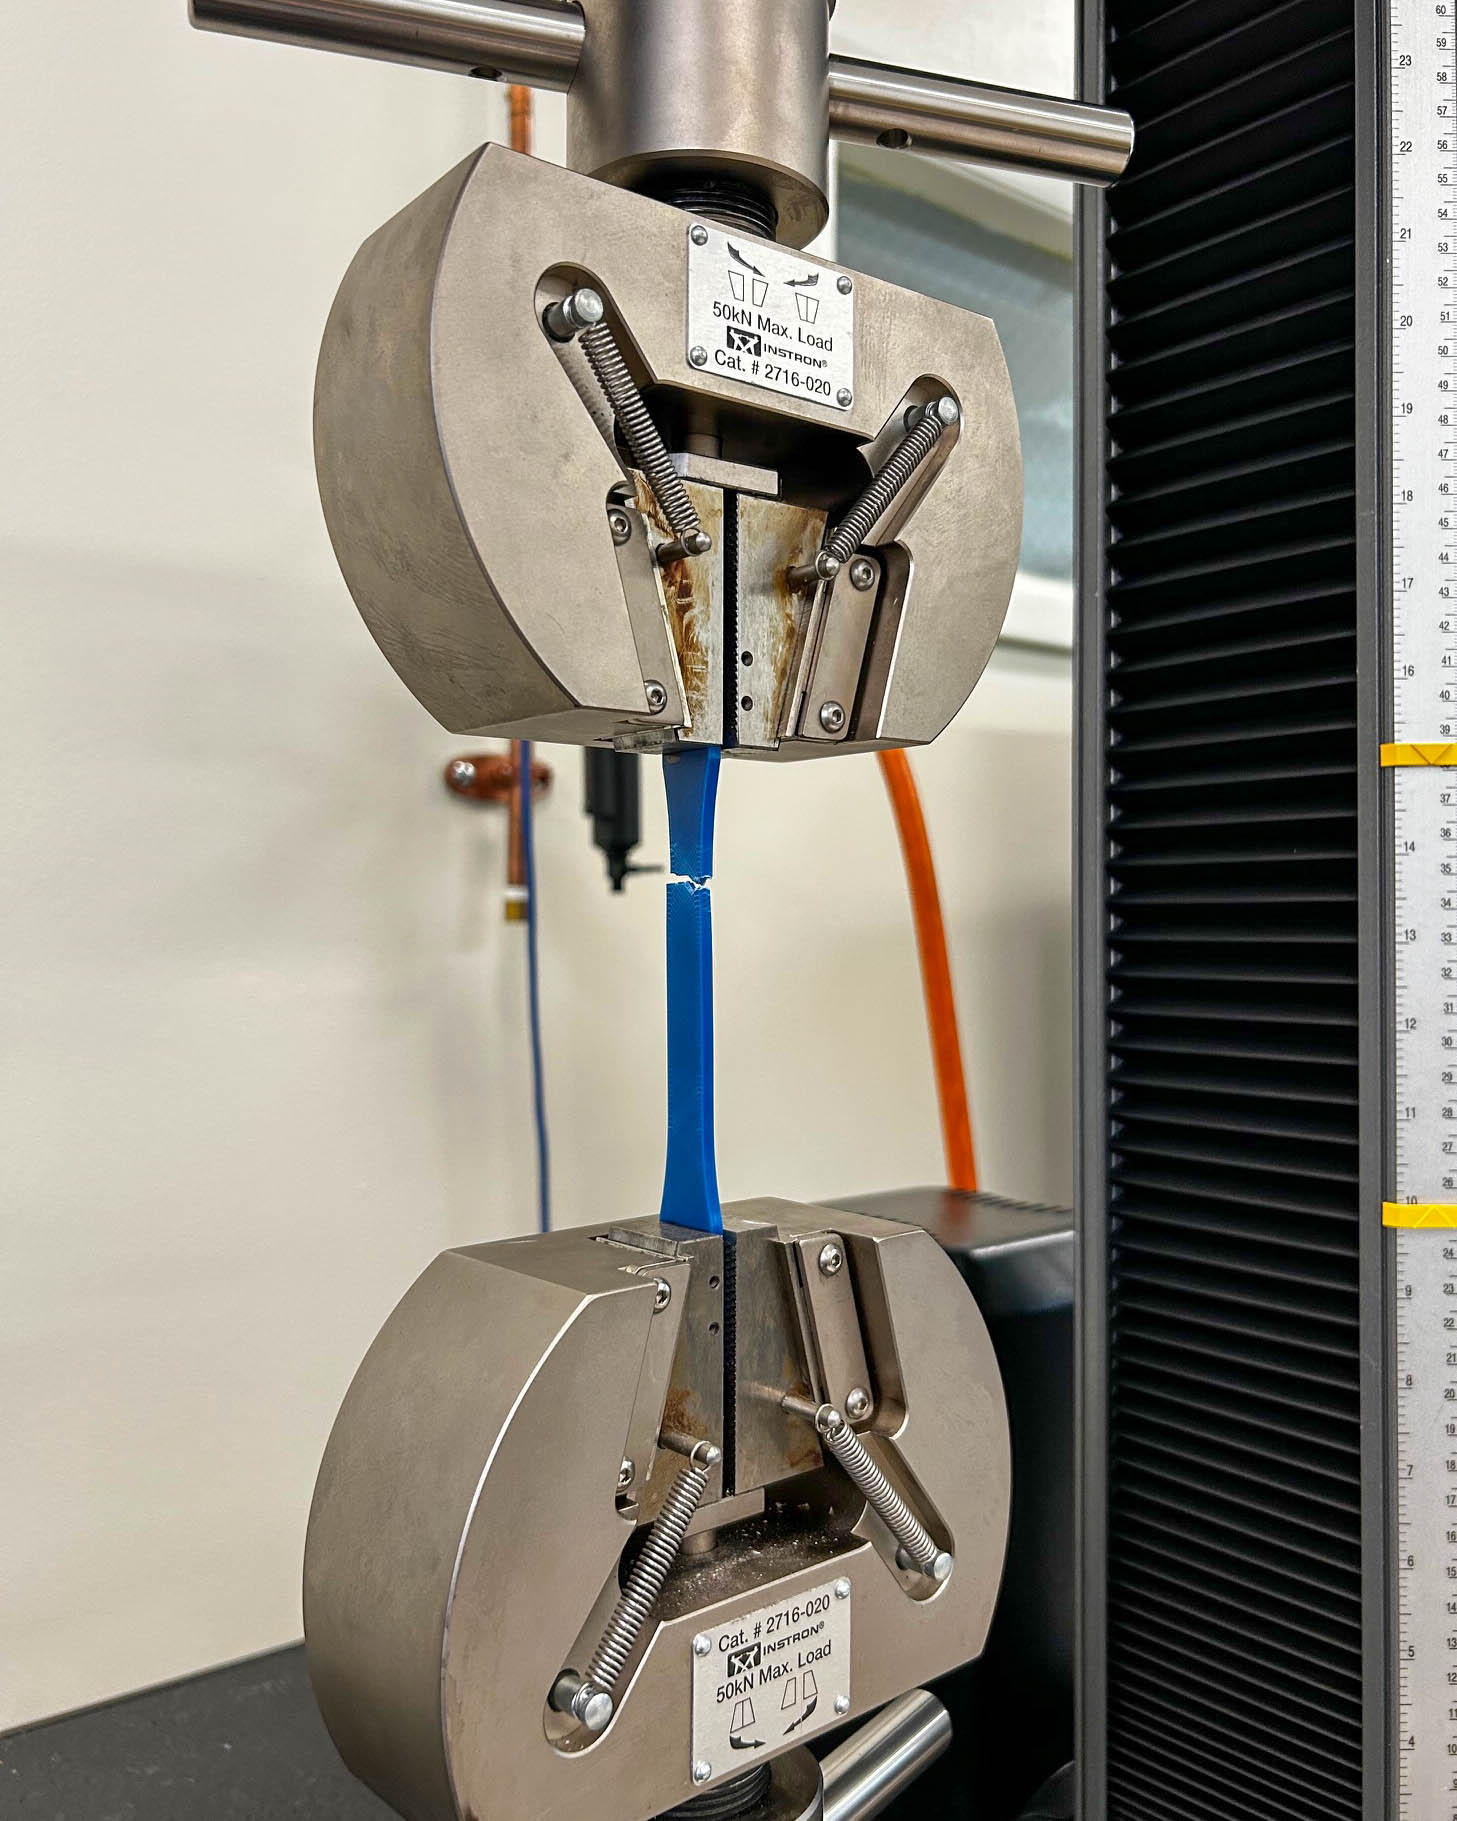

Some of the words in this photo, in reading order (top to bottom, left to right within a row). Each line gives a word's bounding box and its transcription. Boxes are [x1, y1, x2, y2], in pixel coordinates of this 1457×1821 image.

[1436, 5, 1446, 14] 60
[1436, 38, 1446, 47] 59
[1399, 55, 1411, 66] 23
[1437, 72, 1447, 81] 58
[1437, 106, 1447, 115] 57
[1400, 141, 1412, 152] 22
[1437, 140, 1447, 149] 56
[1438, 174, 1447, 183] 55
[1438, 209, 1448, 217] 54
[1400, 228, 1411, 239] 21
[1438, 243, 1448, 252] 53
[1438, 277, 1448, 286] 52
[1400, 315, 1412, 326] 20
[1440, 312, 1450, 320] 51
[713, 300, 752, 327] 50kN
[757, 313, 793, 340] Max.
[798, 326, 833, 352] Load
[1438, 346, 1448, 355] 50
[715, 349, 746, 372] Cat.
[751, 360, 760, 376] #
[765, 363, 831, 396] 2716-020
[1438, 380, 1448, 389] 49
[1401, 403, 1412, 414] 19
[1438, 415, 1448, 424] 48
[1438, 449, 1448, 458] 47
[1438, 483, 1448, 492] 46
[1401, 489, 1413, 501] 18
[1438, 518, 1448, 527] 45
[1438, 552, 1448, 561] 44
[1402, 578, 1413, 588] 17
[1439, 587, 1449, 596] 43
[1439, 621, 1449, 631] 42
[1442, 656, 1451, 665] 41
[1403, 665, 1414, 676] 16
[1440, 690, 1450, 700] 40
[1440, 725, 1450, 734] 39
[1440, 794, 1450, 803] 37
[1440, 828, 1451, 837] 36
[1404, 841, 1415, 852] 14
[1441, 864, 1451, 873] 35
[1441, 898, 1451, 908] 34
[1405, 930, 1416, 941] 13
[1441, 933, 1451, 942] 33
[1441, 968, 1452, 977] 32
[1444, 1003, 1453, 1012] 31
[1405, 1018, 1416, 1029] 12
[1442, 1037, 1452, 1046] 30
[1442, 1072, 1452, 1081] 29
[1405, 1107, 1415, 1118] 11
[1442, 1107, 1452, 1117] 28
[1442, 1142, 1453, 1152] 27
[1442, 1177, 1453, 1187] 26
[1443, 1248, 1453, 1258] 24
[1406, 1285, 1412, 1296] 9
[1443, 1284, 1454, 1293] 23
[1444, 1319, 1454, 1328] 22
[1447, 1353, 1456, 1362] 21
[1406, 1375, 1412, 1386] 8
[1444, 1390, 1455, 1399] 20
[1446, 1424, 1455, 1433] 19
[1446, 1460, 1455, 1469] 18
[1407, 1465, 1413, 1475] 7
[1446, 1496, 1456, 1505] 17
[1446, 1531, 1456, 1541] 16
[1407, 1555, 1414, 1566] 6
[1447, 1567, 1456, 1576] 15
[1447, 1603, 1456, 1612] 14
[718, 1628, 749, 1652] Cat.
[753, 1621, 762, 1639] #
[766, 1594, 830, 1634] 2716-020
[1447, 1638, 1457, 1647] 13
[1408, 1646, 1414, 1657] 5
[716, 1673, 754, 1704] 50kN
[759, 1661, 793, 1686] Max.
[799, 1639, 832, 1668] Load
[1447, 1673, 1457, 1682] 12
[1409, 1736, 1415, 1747] 4
[1448, 1744, 1457, 1753] 10
